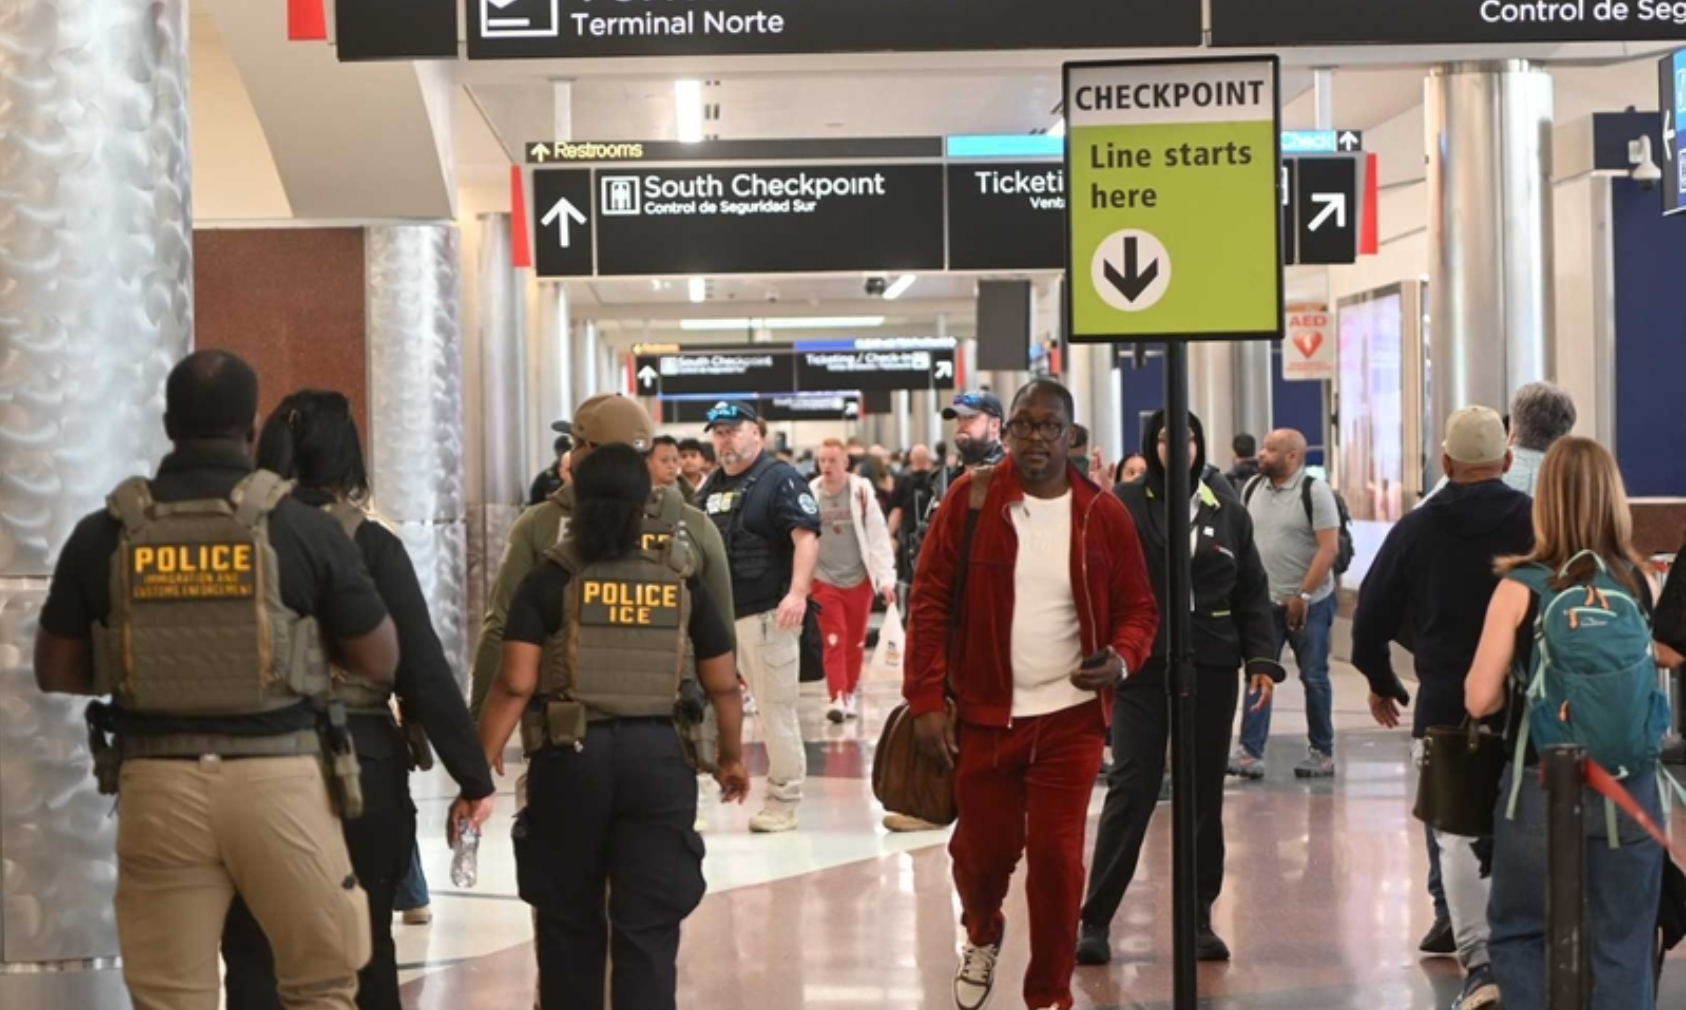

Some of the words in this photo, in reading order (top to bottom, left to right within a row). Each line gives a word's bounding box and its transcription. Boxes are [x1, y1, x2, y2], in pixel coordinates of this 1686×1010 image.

[570, 10, 694, 36] Terminal
[703, 10, 785, 34] Norte
[1480, 0, 1584, 22] Control
[1593, 0, 1629, 21] de
[1637, 0, 1686, 24] Seg
[1075, 80, 1264, 111] CHECKPOINT
[554, 141, 644, 159] Restrooms
[1090, 142, 1152, 169] Line
[1164, 141, 1253, 167] starts
[644, 173, 723, 198] South
[731, 172, 886, 200] Checkpoint
[1090, 182, 1157, 209] here
[644, 200, 696, 214] Control
[698, 200, 717, 214] de
[720, 199, 790, 216] Seguridad
[793, 198, 817, 213] Sur
[1289, 315, 1329, 328] AED
[135, 544, 251, 574] POLICE
[584, 581, 678, 608] POLICE
[609, 605, 651, 625] ICE
